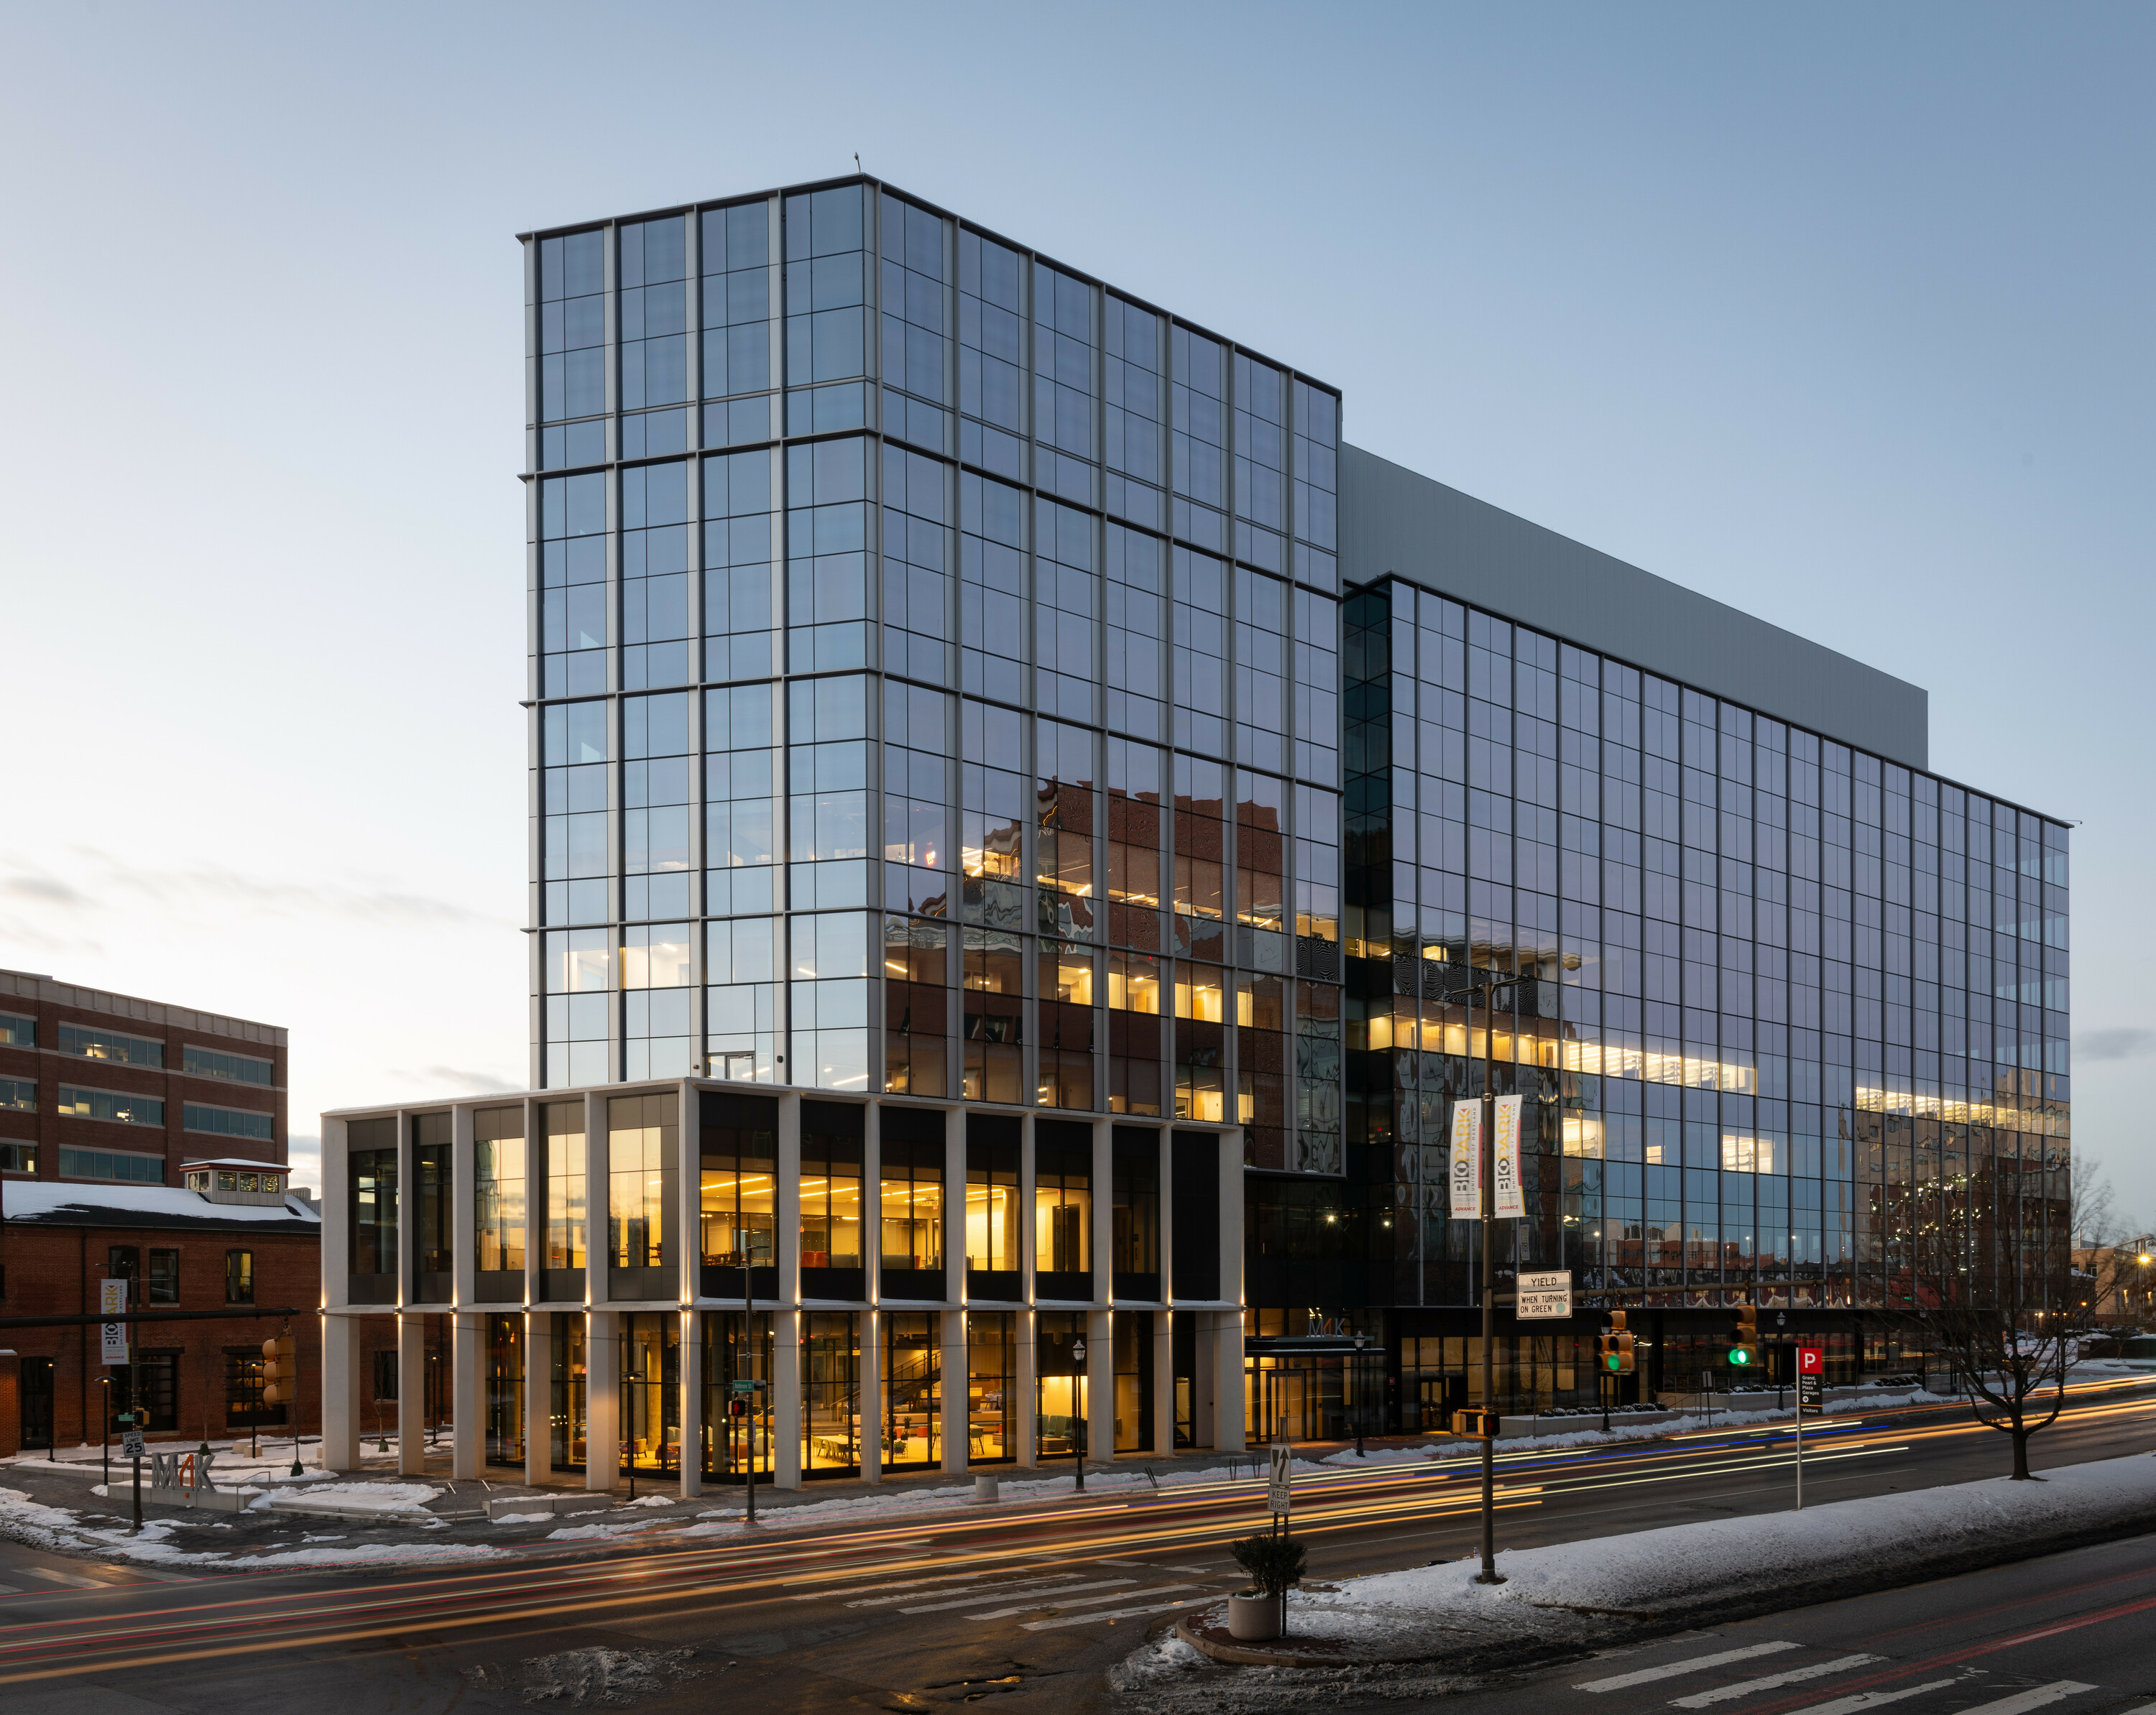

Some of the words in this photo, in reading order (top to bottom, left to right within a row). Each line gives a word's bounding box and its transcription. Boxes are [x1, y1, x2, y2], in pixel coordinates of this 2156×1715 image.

[1454, 1109, 1472, 1191] BIOPARK
[1471, 1143, 1475, 1152] OF
[1498, 1104, 1512, 1190] BIOPARK
[1531, 1277, 1557, 1287] YIELD
[1531, 1305, 1552, 1313] GREEN
[105, 1286, 118, 1345] BIOARK
[1805, 1353, 1816, 1368] P
[126, 1442, 142, 1453] 25
[1272, 1490, 1288, 1499] KEEP
[1270, 1500, 1288, 1510] RIGHT
